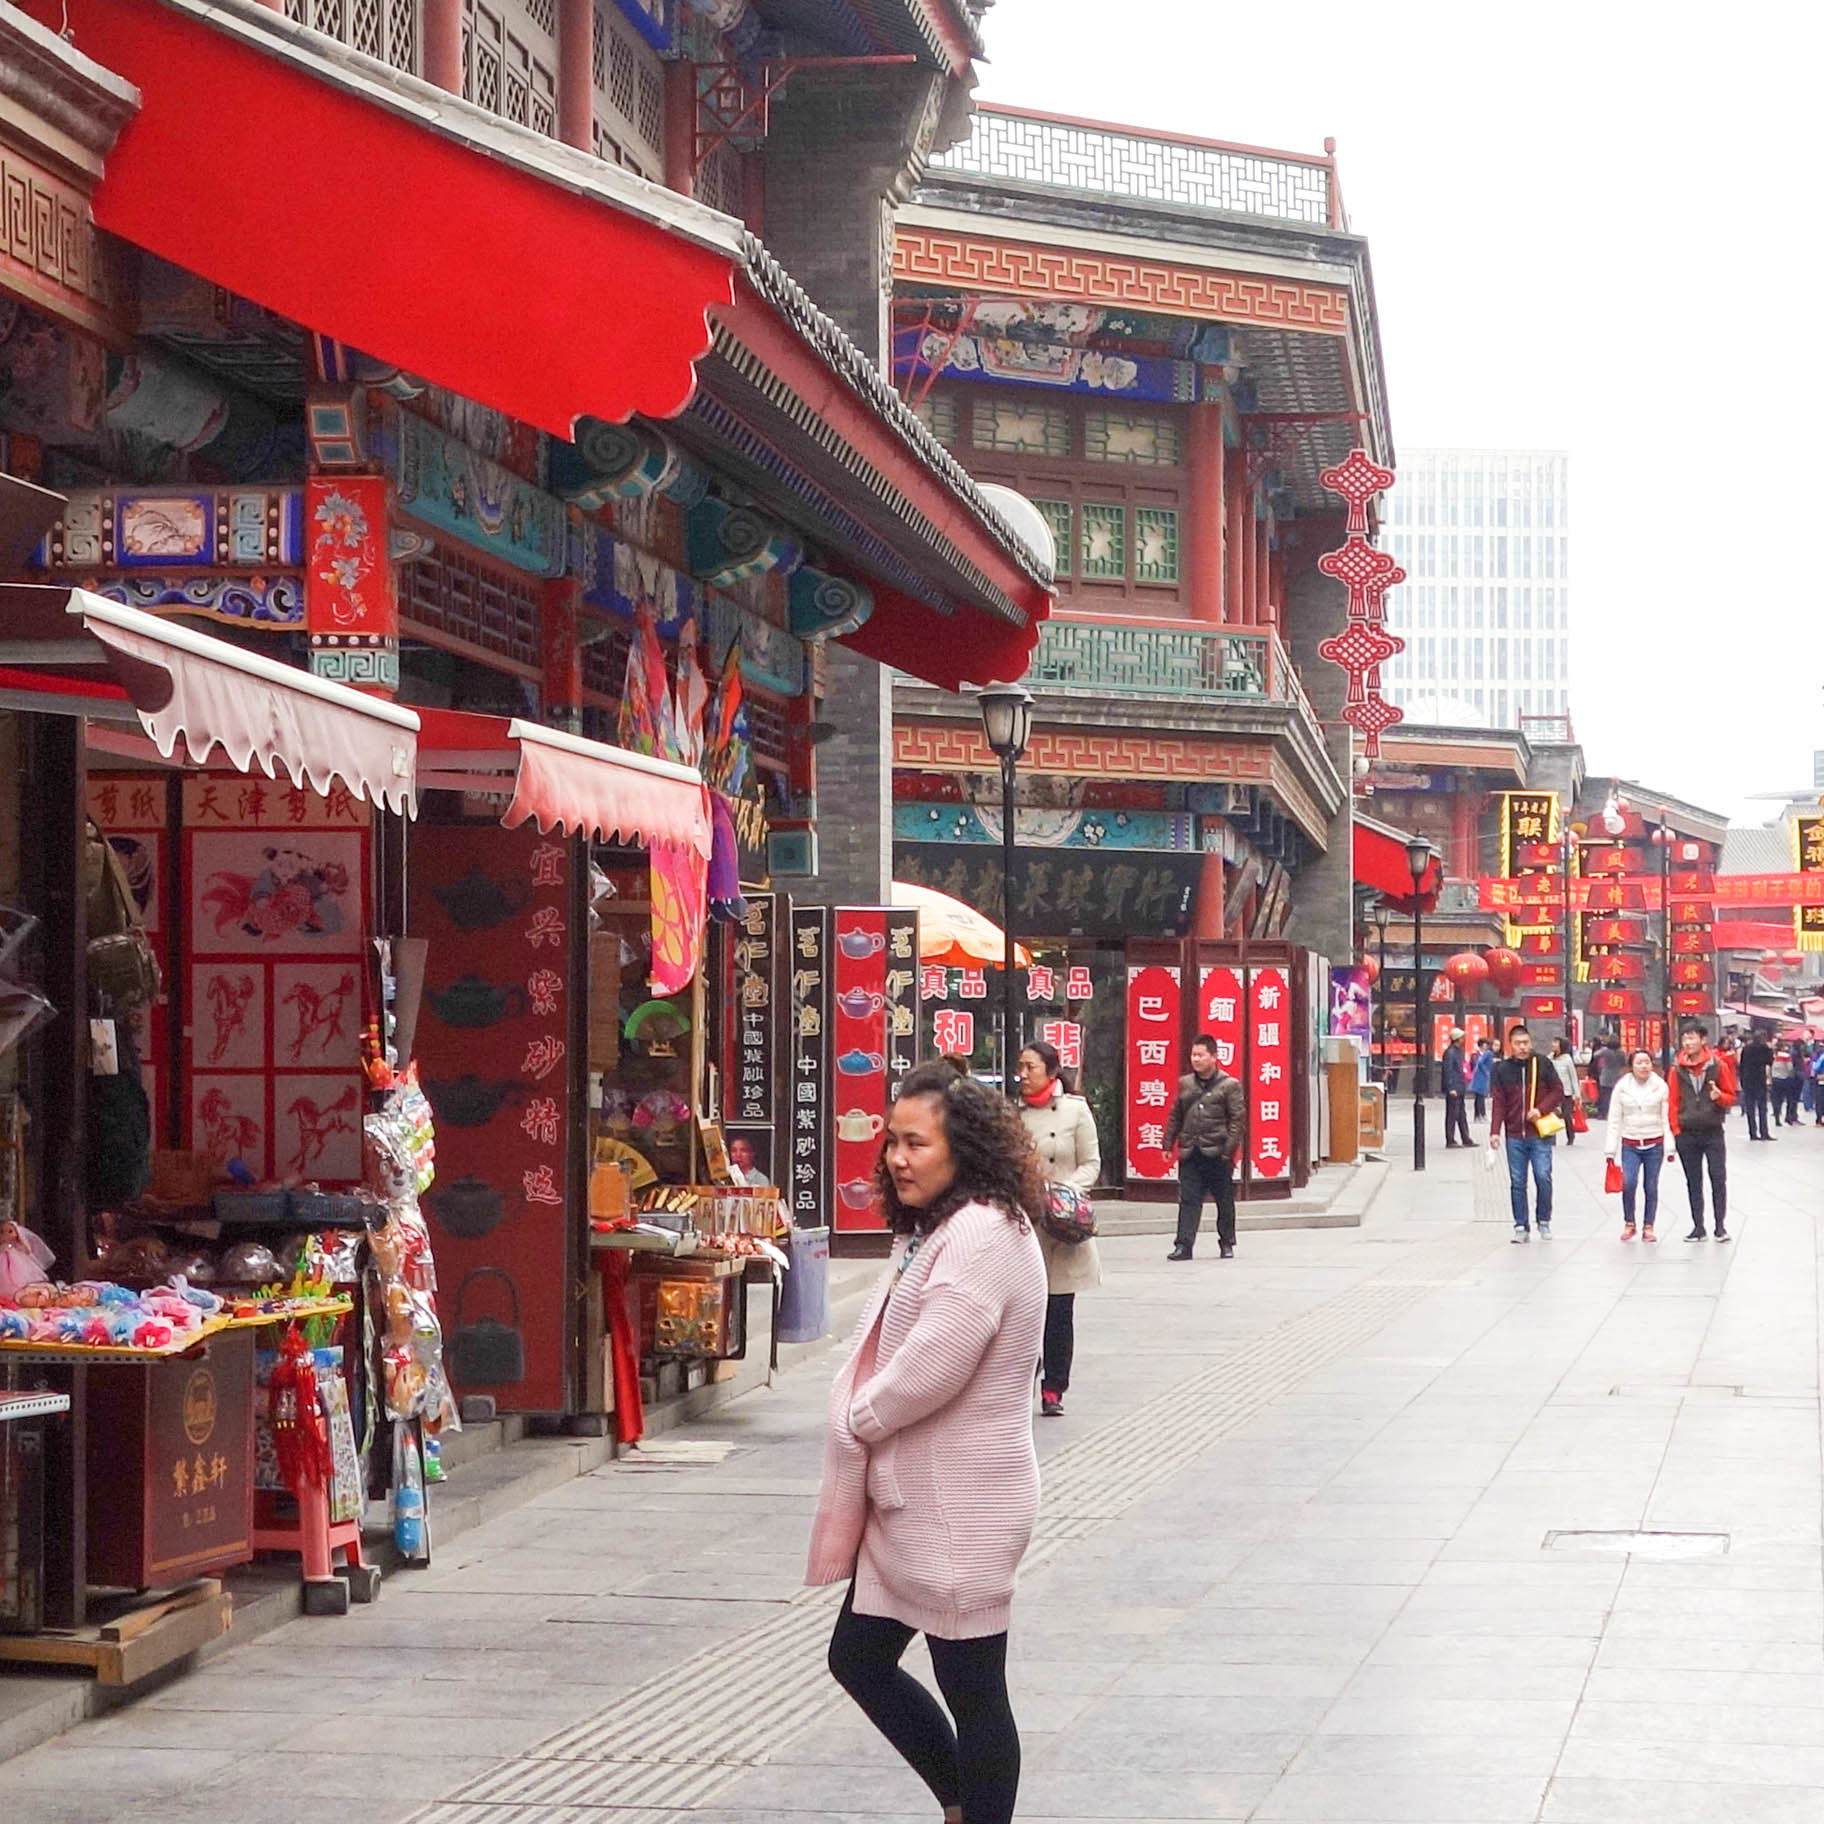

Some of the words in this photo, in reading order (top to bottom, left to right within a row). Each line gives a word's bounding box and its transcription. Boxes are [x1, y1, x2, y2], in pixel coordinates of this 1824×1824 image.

[197, 784, 360, 825] 天津剪纸
[520, 843, 565, 1206] 宜兴紫砂精选
[920, 965, 987, 1001] 真品
[1027, 966, 1093, 1001] 真品
[1136, 996, 1171, 1150] 巴西碧玺
[1257, 986, 1283, 1160] 新疆和田玉
